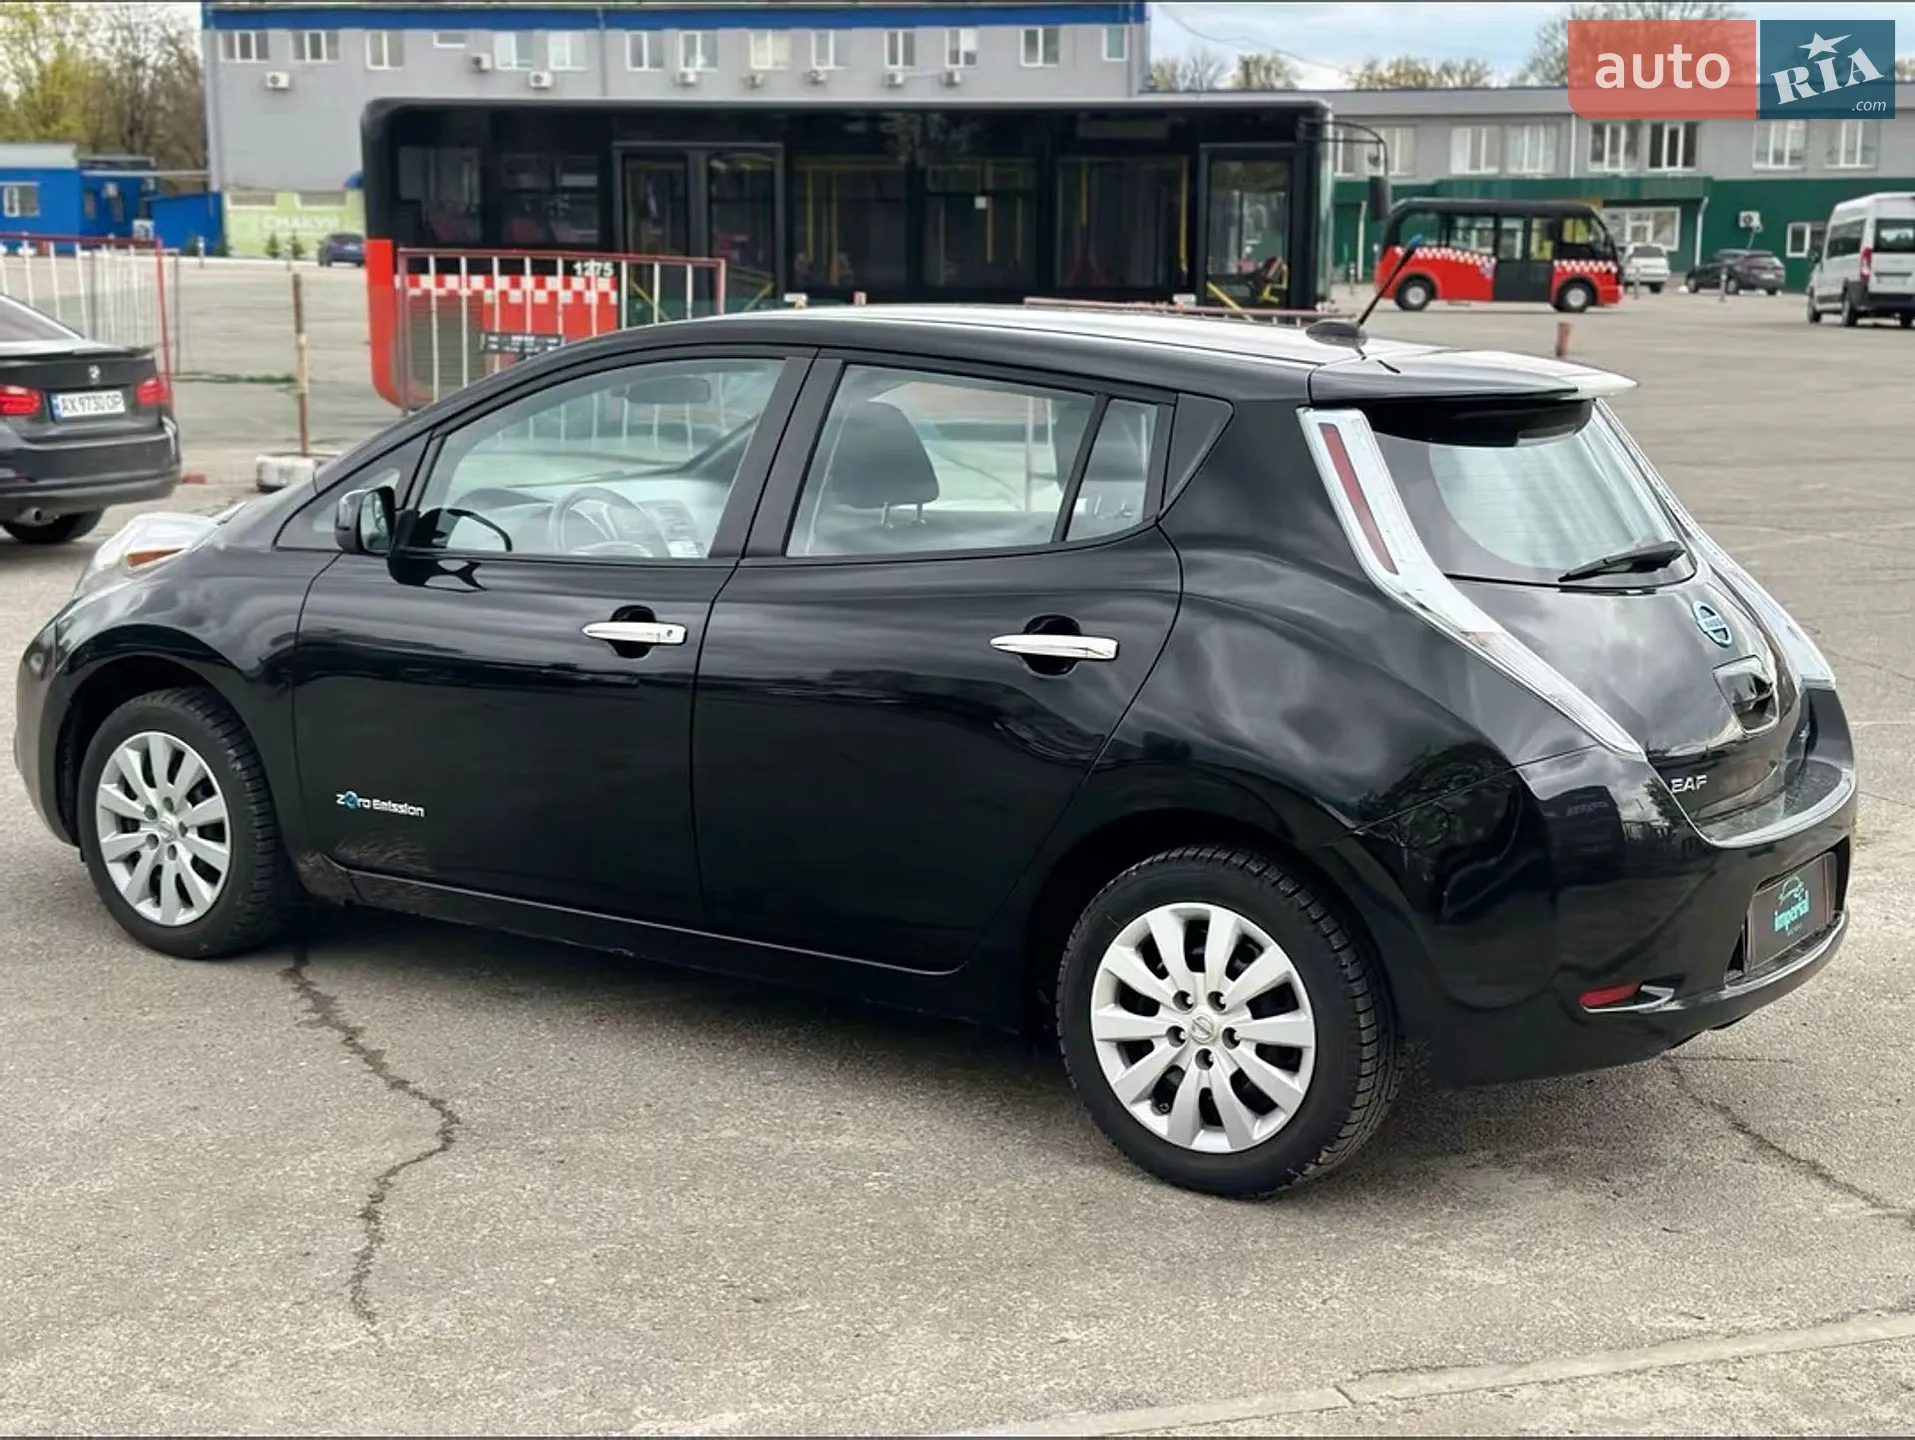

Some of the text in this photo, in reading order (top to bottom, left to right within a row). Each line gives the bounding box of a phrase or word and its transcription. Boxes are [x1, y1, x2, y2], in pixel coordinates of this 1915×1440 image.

[573, 261, 614, 276] 1275
[1671, 774, 1707, 793] EAF
[372, 799, 425, 817] Emission
